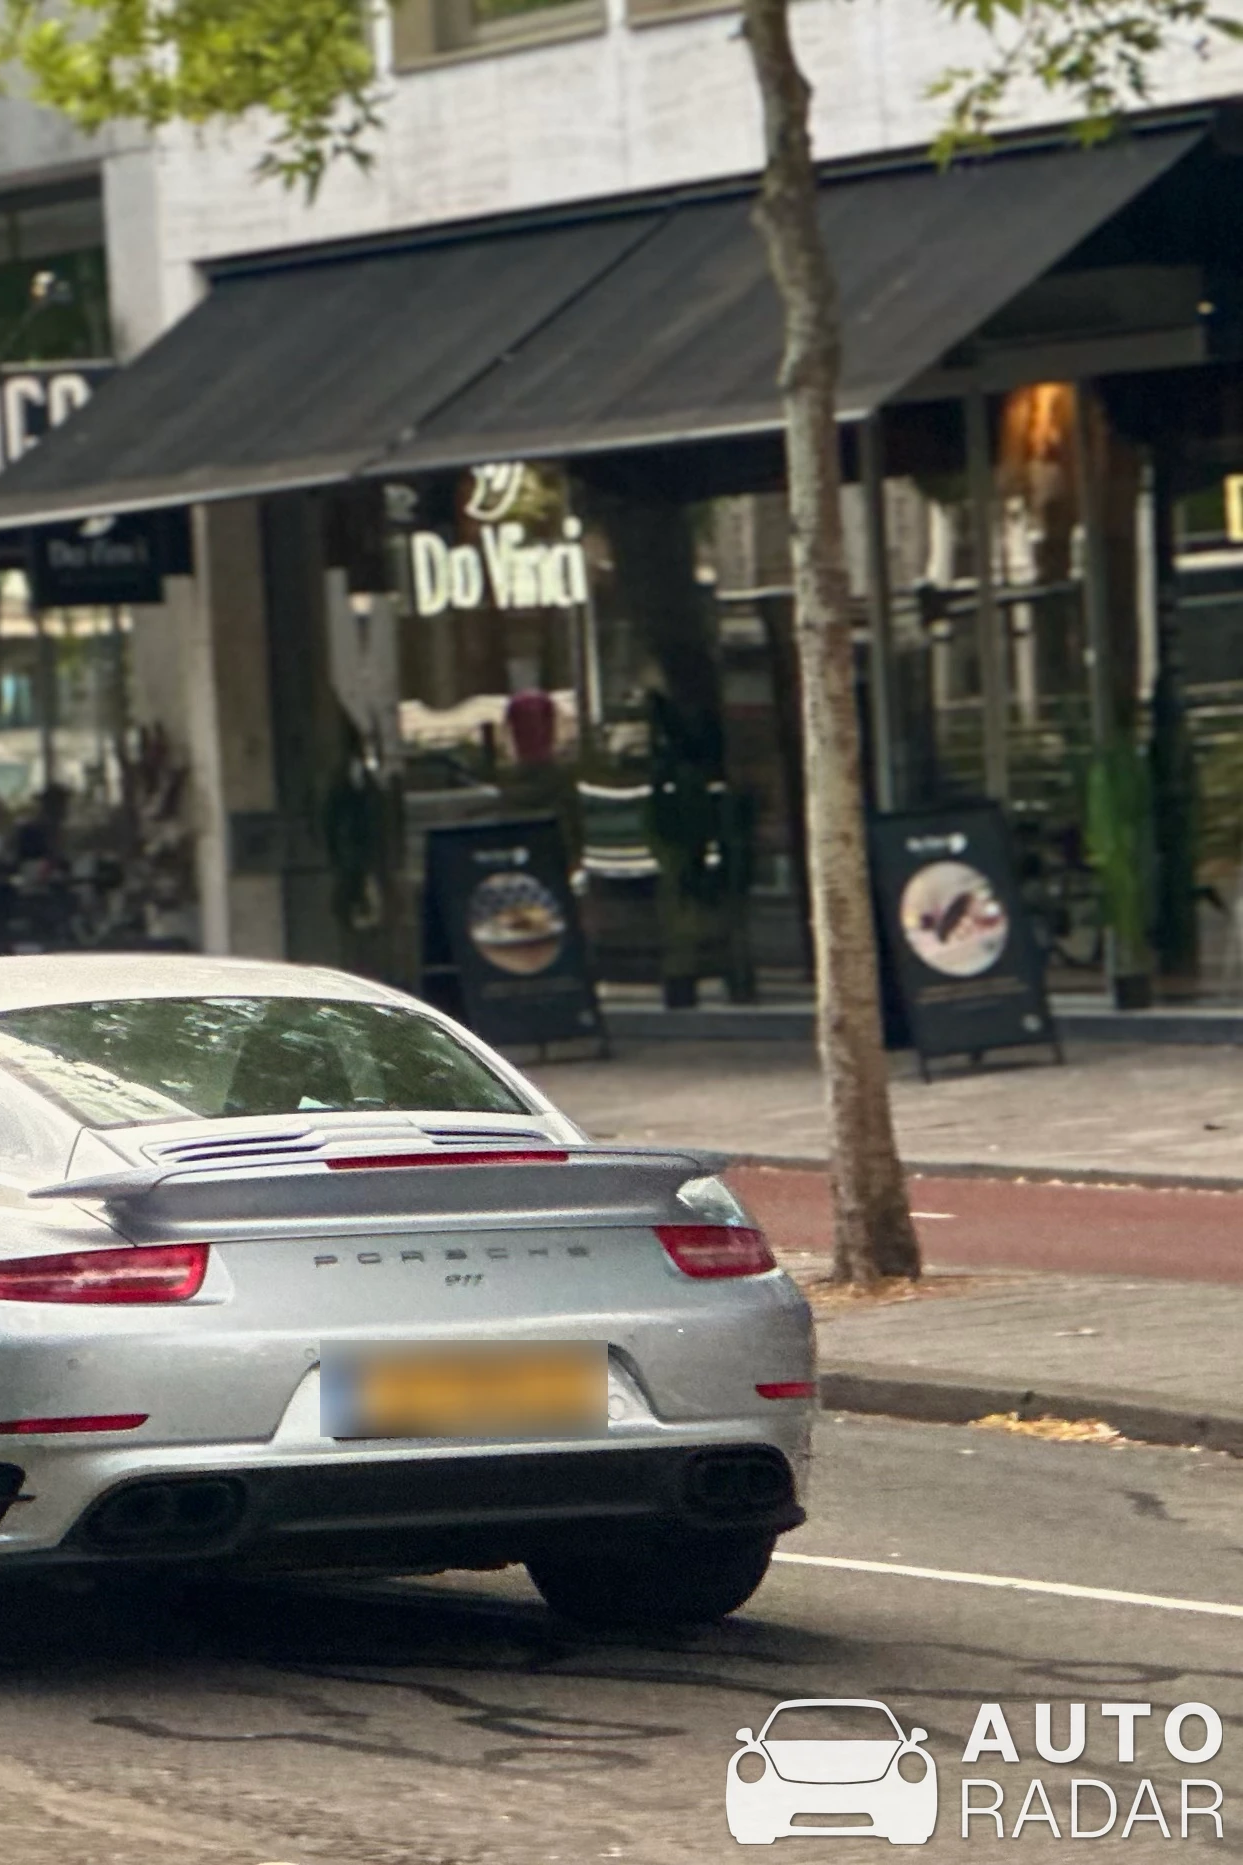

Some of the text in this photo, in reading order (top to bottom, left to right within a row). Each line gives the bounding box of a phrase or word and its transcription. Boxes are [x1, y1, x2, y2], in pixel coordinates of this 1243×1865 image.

[480, 514, 589, 610] Vinci
[313, 1246, 590, 1268] PORSCHE
[444, 1273, 484, 1287] 911
